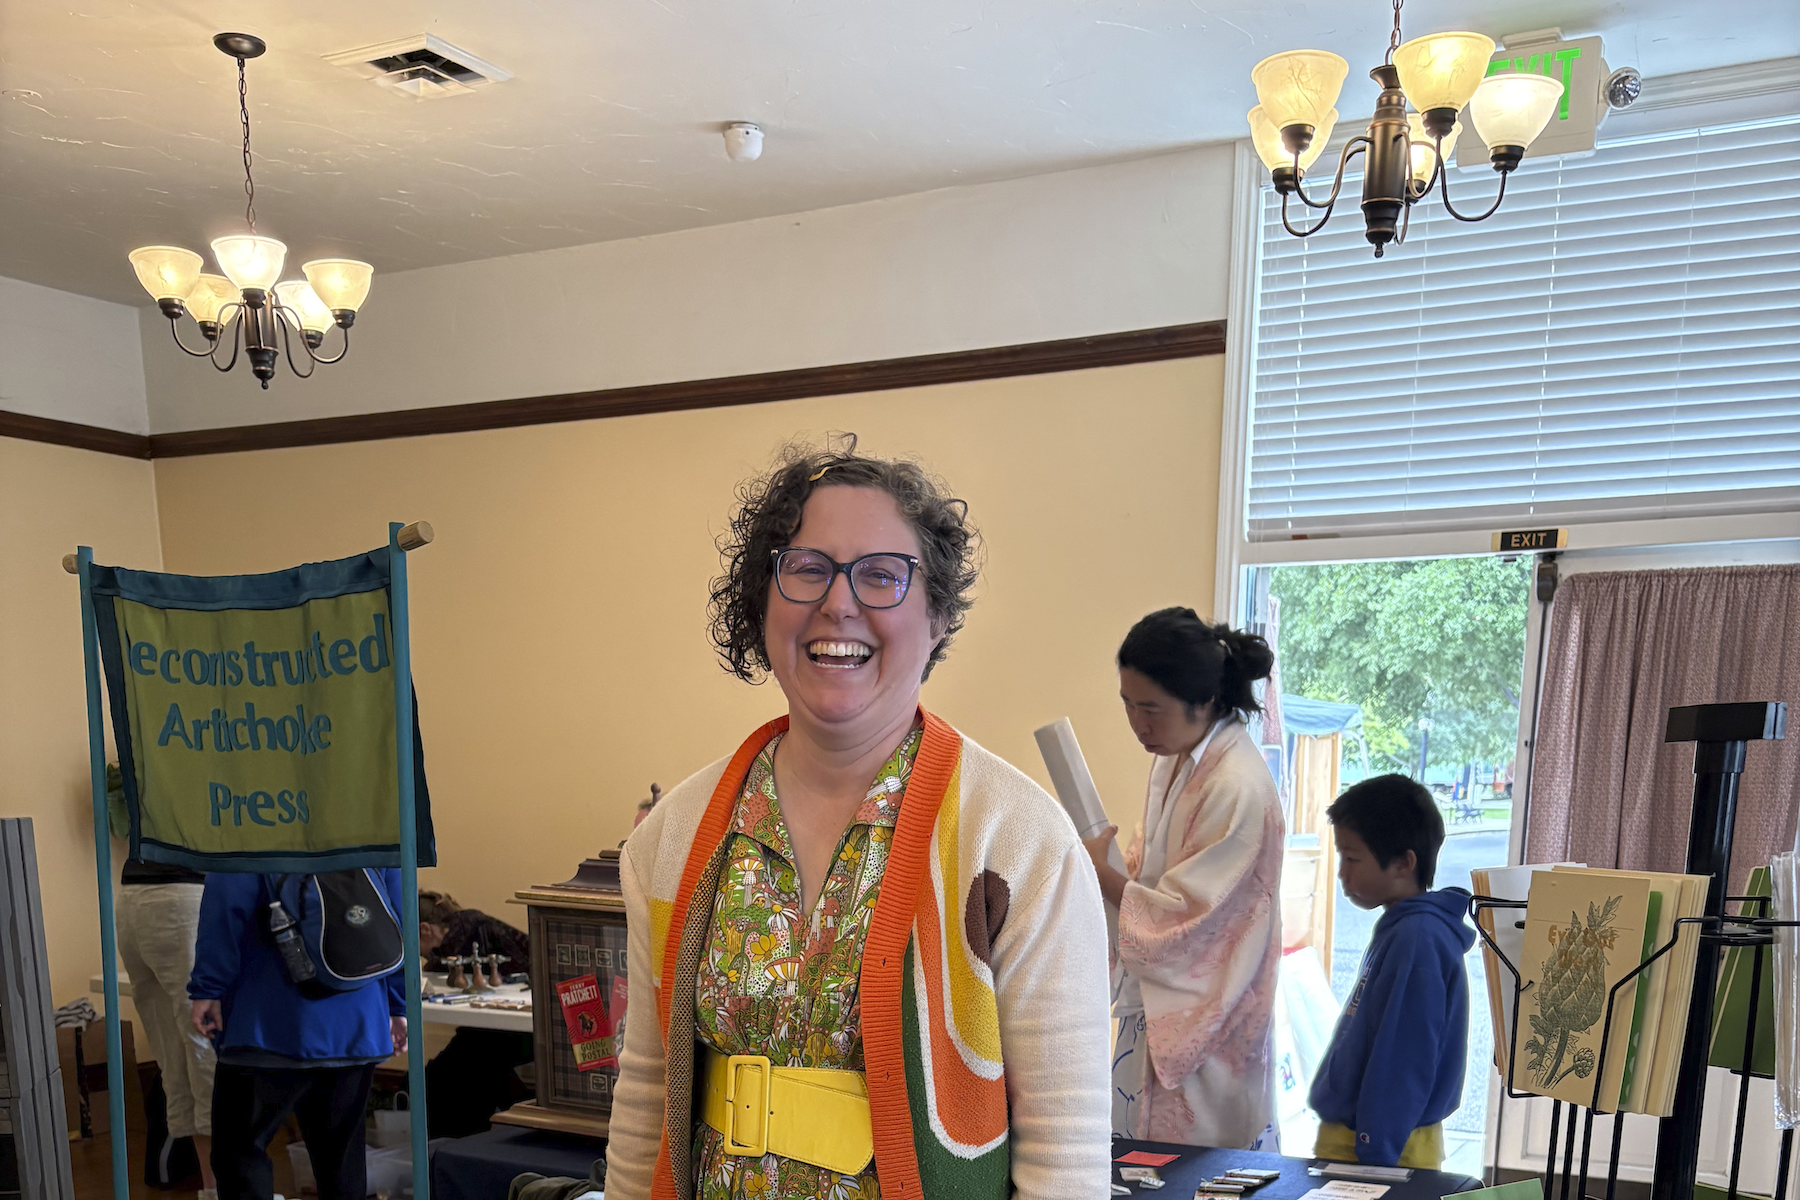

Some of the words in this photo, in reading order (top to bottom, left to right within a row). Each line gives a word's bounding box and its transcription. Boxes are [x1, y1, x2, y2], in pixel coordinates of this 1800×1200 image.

[1511, 532, 1547, 549] EXIT
[127, 613, 390, 687] econstructed
[157, 702, 331, 756] Artichoke
[209, 781, 310, 826] Press
[561, 985, 598, 1007] PRATCHETT
[581, 1039, 606, 1053] GOING
[582, 1048, 611, 1061] POSTAL
